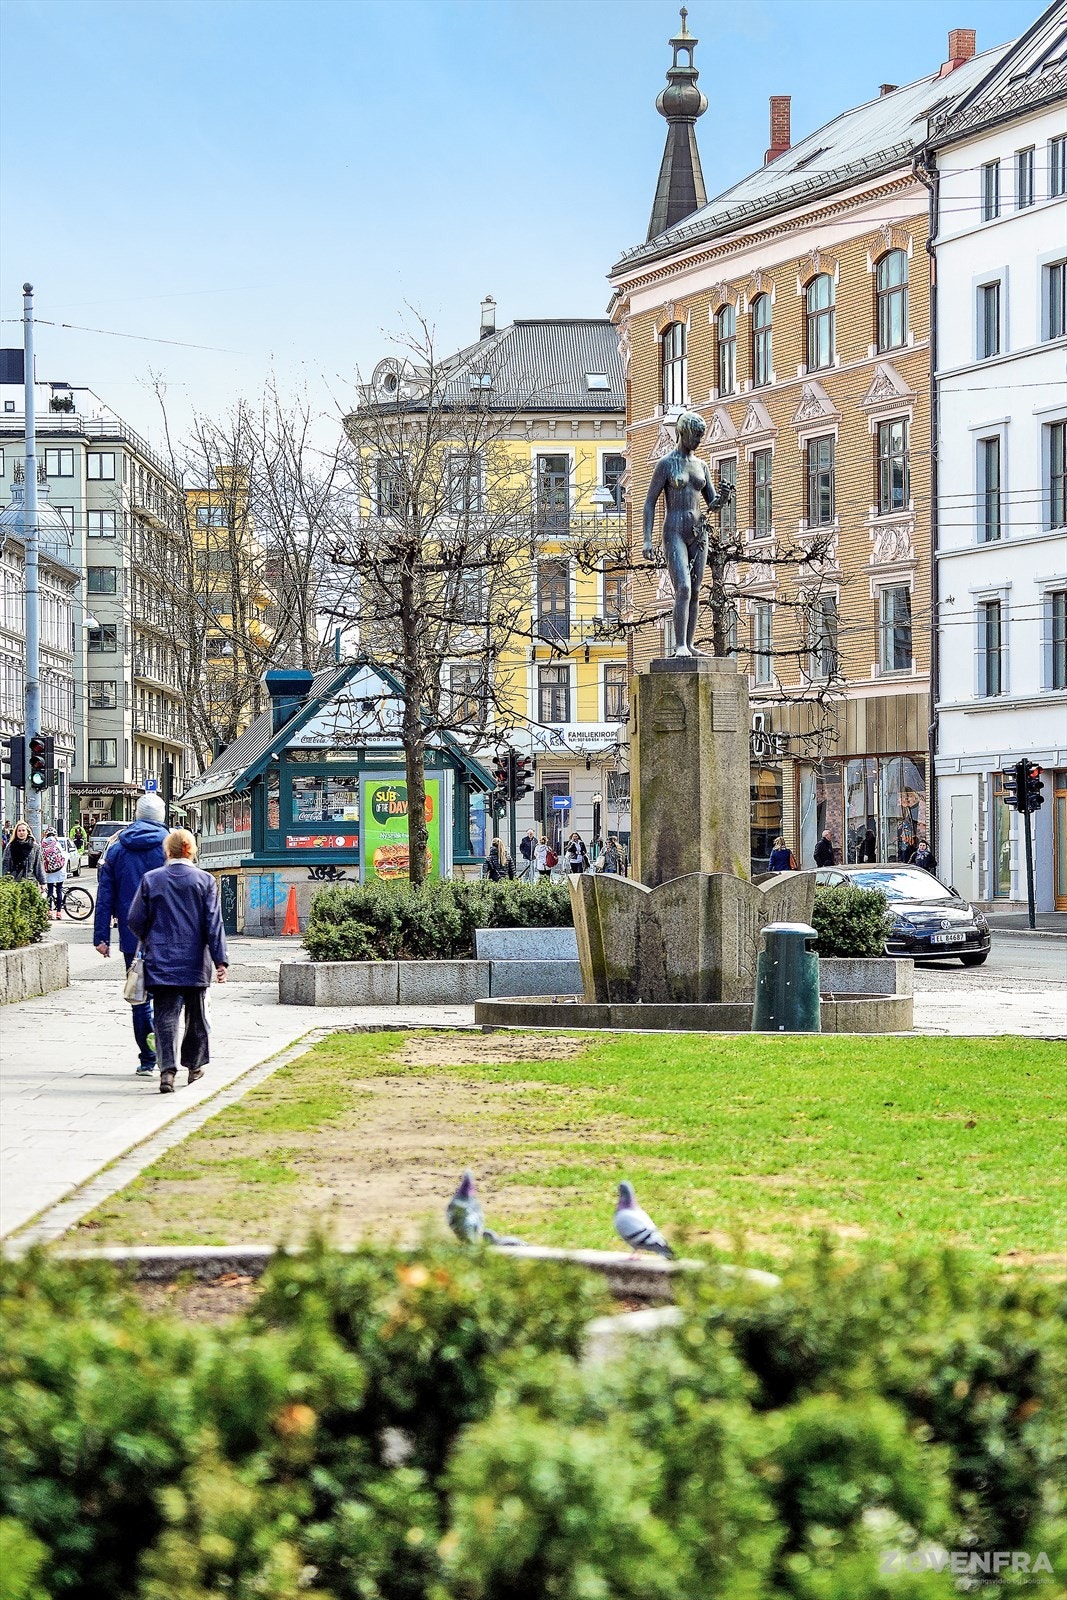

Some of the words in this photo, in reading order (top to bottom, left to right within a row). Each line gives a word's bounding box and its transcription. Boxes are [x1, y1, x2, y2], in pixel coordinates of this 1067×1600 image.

[147, 780, 154, 789] P
[376, 791, 397, 802] SUB
[389, 801, 408, 814] DAY
